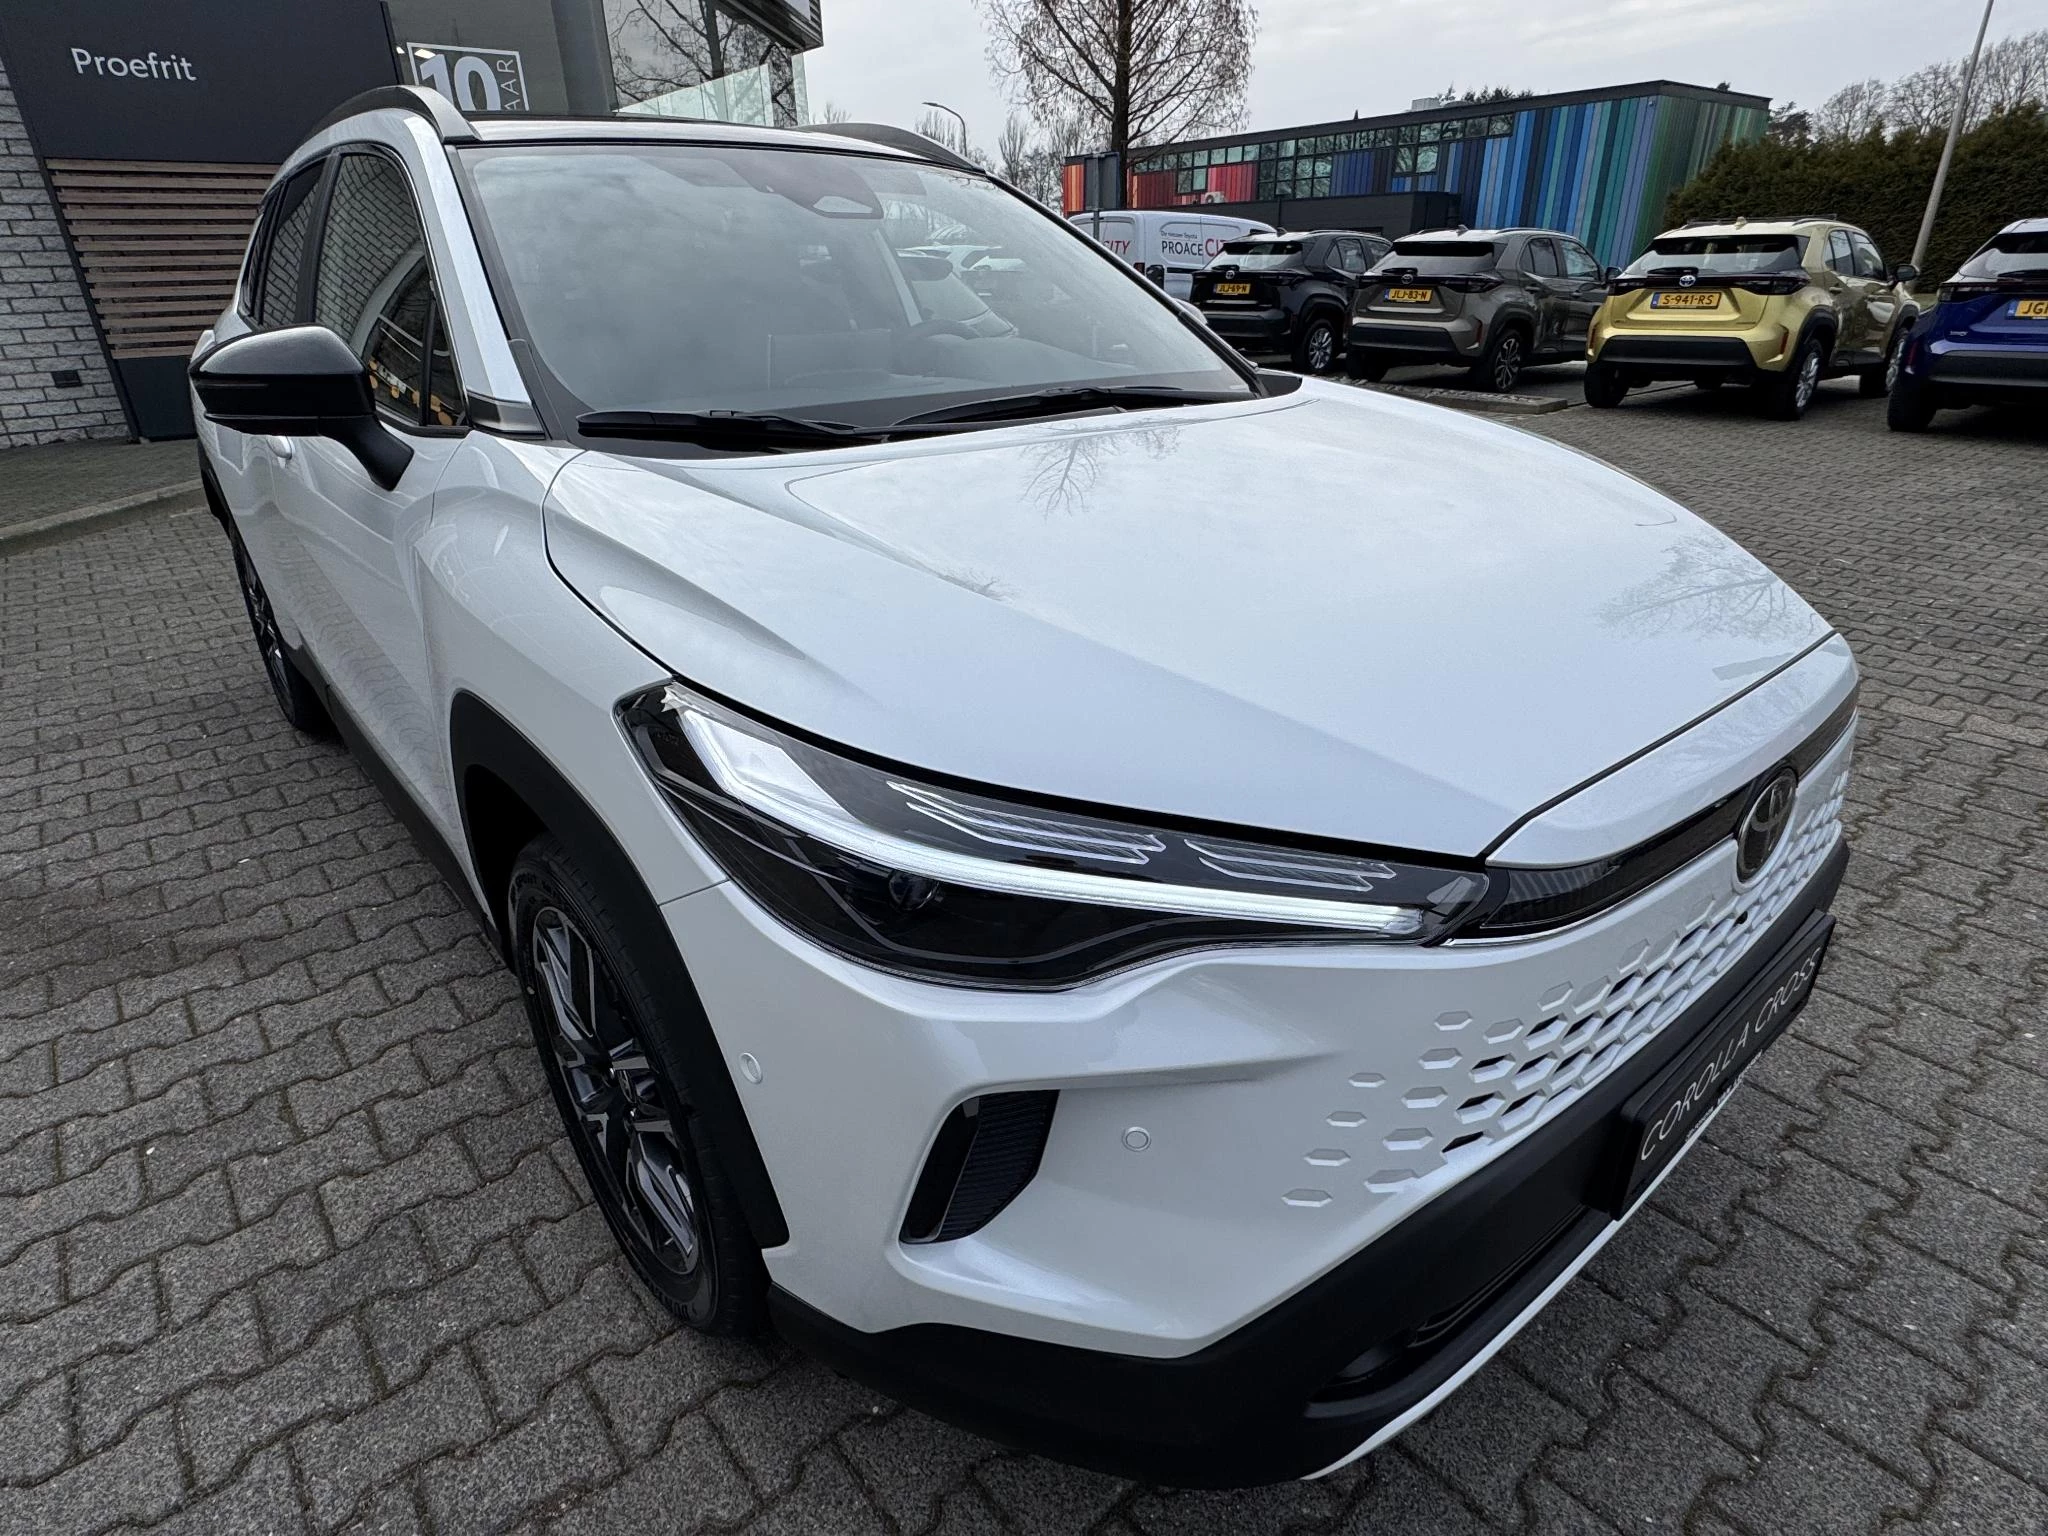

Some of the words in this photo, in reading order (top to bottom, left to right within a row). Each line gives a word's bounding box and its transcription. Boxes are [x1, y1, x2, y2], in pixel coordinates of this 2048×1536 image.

[71, 47, 197, 82] Proefrit
[420, 53, 502, 112] 10
[495, 59, 522, 112] AAR
[1103, 240, 1131, 255] ITY
[1161, 240, 1204, 257] PROACE
[1391, 288, 1428, 301] JLJ-83-N
[1662, 294, 1715, 305] S-941-RS
[1641, 1021, 1750, 1161] COROLLA
[1755, 946, 1821, 1033] CROSS
